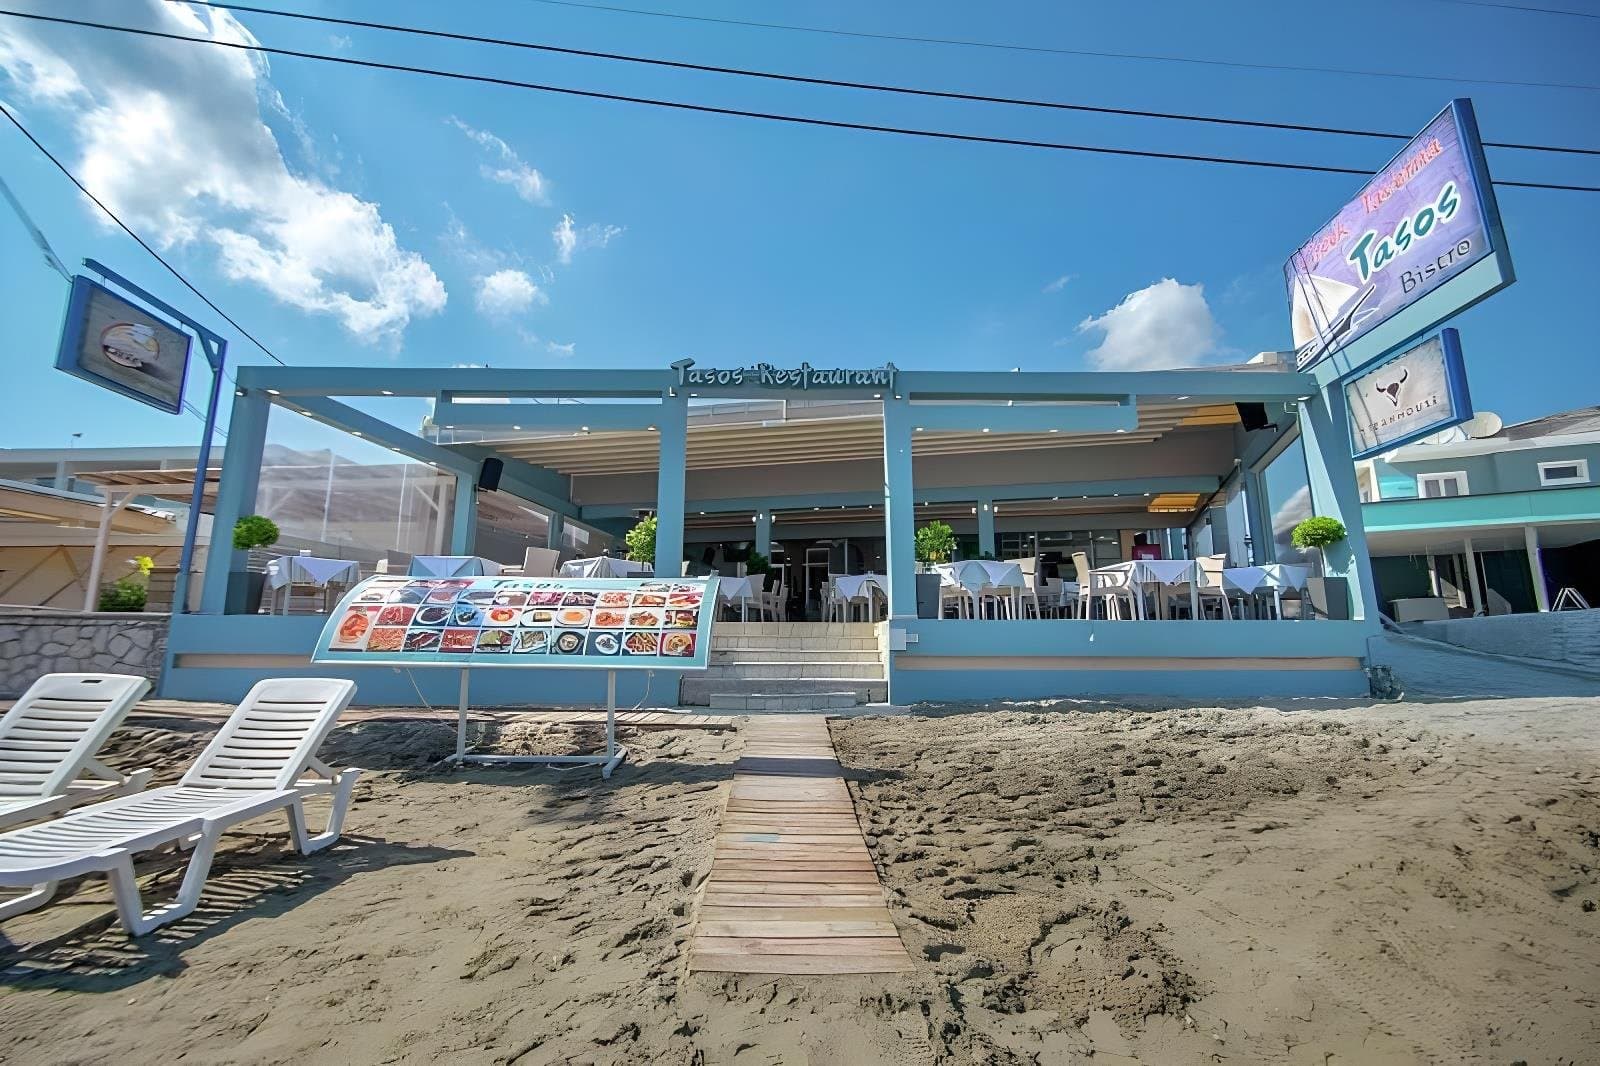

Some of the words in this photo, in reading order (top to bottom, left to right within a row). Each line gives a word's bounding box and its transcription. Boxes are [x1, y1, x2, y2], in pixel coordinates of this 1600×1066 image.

[1348, 183, 1460, 283] Tasos
[1400, 239, 1471, 294] Bistro
[671, 358, 744, 385] Tasos
[758, 361, 898, 391] Restaurant
